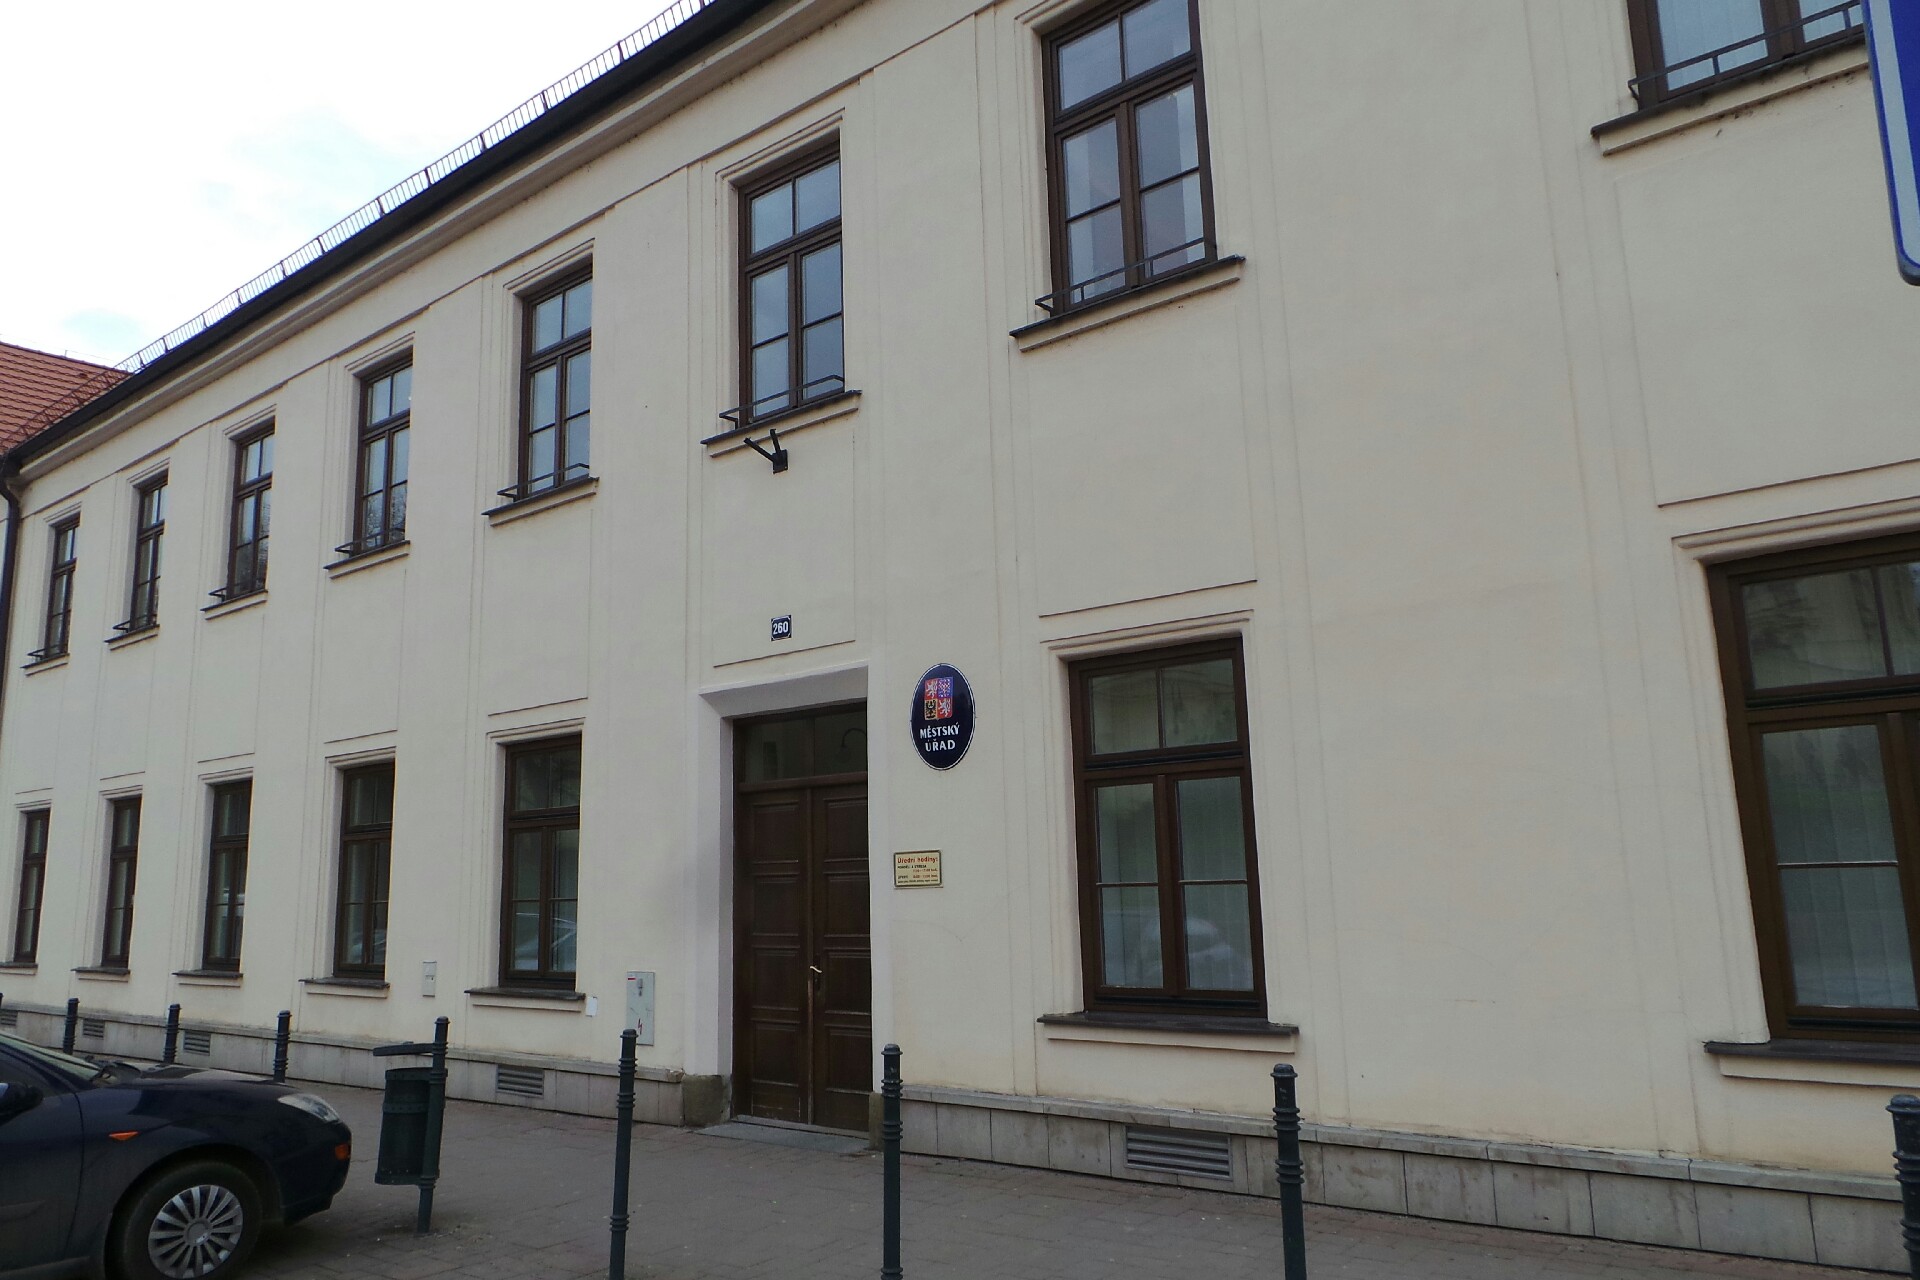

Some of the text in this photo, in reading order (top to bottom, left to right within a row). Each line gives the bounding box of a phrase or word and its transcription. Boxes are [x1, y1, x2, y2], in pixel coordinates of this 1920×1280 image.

[773, 621, 789, 635] 260
[920, 722, 960, 739] MĚSTSKÝ
[925, 738, 956, 752] ÚŘAD
